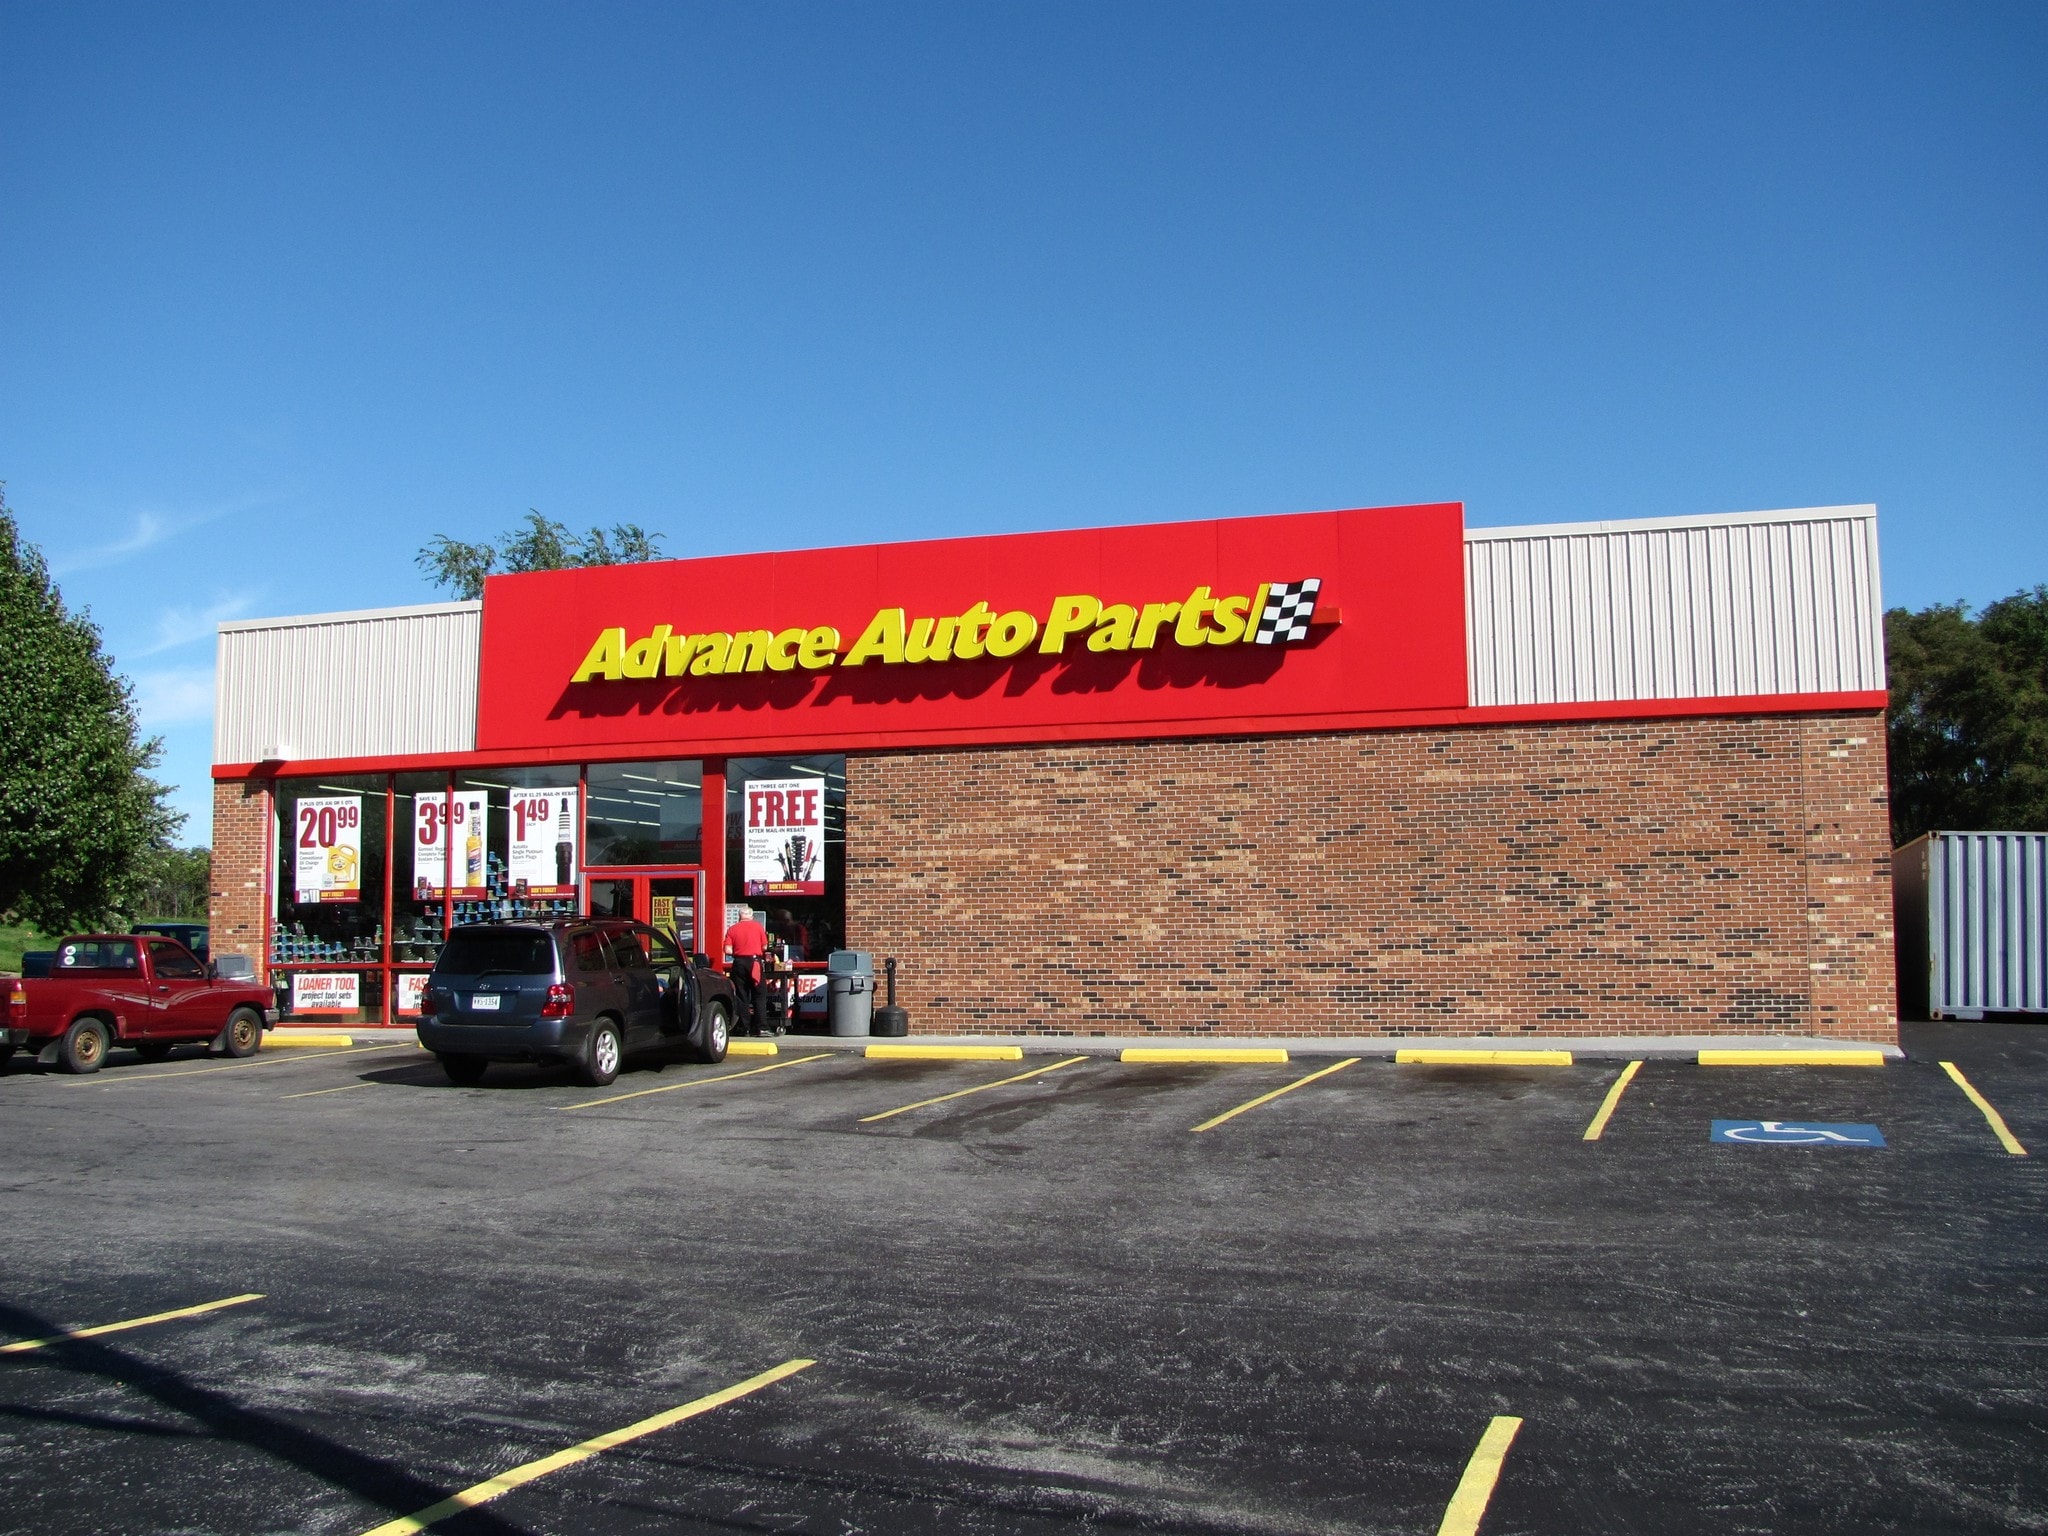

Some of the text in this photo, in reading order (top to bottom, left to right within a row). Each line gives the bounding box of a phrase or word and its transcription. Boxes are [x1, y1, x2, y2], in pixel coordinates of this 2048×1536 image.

[570, 585, 1251, 683] Advance Auto Parts
[749, 789, 818, 827] FREE
[654, 899, 670, 907] FAST
[654, 908, 671, 916] FREE
[298, 977, 356, 990] LOANER TOOL
[409, 978, 427, 991] FAS
[301, 992, 323, 1000] project
[311, 1000, 341, 1008] available
